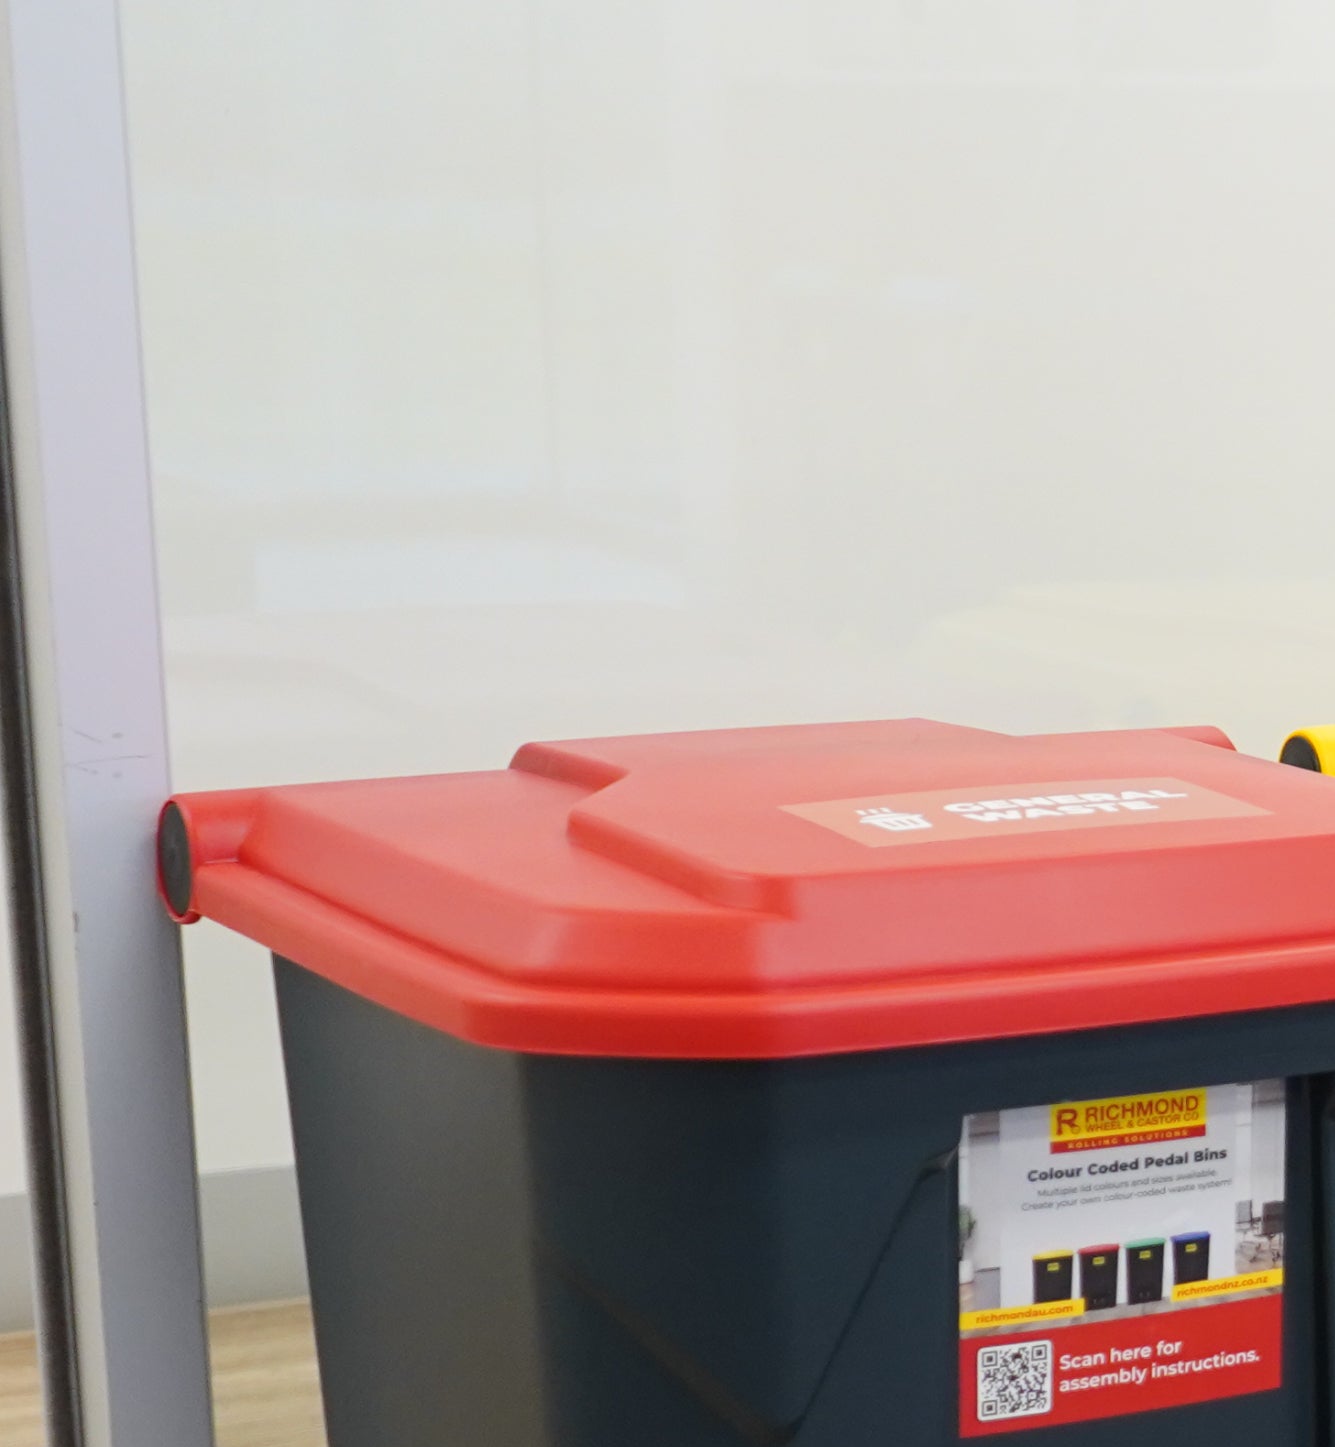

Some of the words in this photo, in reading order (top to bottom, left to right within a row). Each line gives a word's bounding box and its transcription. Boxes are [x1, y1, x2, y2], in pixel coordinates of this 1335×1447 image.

[943, 789, 1188, 812] GENERAL
[961, 800, 1160, 822] WASTE
[1085, 1095, 1199, 1123] RICHMOND
[1087, 1119, 1122, 1133] WHEEL
[1127, 1119, 1134, 1129] &
[1137, 1114, 1181, 1127] CASTOR
[1183, 1111, 1199, 1121] CO
[1068, 1137, 1118, 1149] ROLLING
[1124, 1130, 1189, 1143] SOLUTIONS
[1027, 1166, 1082, 1182] Colour
[1088, 1158, 1139, 1175] Coded
[1144, 1152, 1189, 1169] Pedal
[1194, 1148, 1228, 1162] Bins
[1094, 1179, 1129, 1191] colours
[1131, 1176, 1150, 1187] and
[1021, 1201, 1053, 1212] Create
[1055, 1197, 1080, 1211] your
[1103, 1186, 1166, 1203] colour-coded
[1169, 1183, 1196, 1194] waste
[1176, 1275, 1269, 1298] richmondnz.co.nz
[976, 1303, 1073, 1324] richmondau.com
[1059, 1351, 1106, 1371] Scan
[1110, 1345, 1151, 1363] here
[1156, 1338, 1183, 1356] for
[1059, 1365, 1148, 1393] assembly
[1151, 1348, 1261, 1379] instructions.
